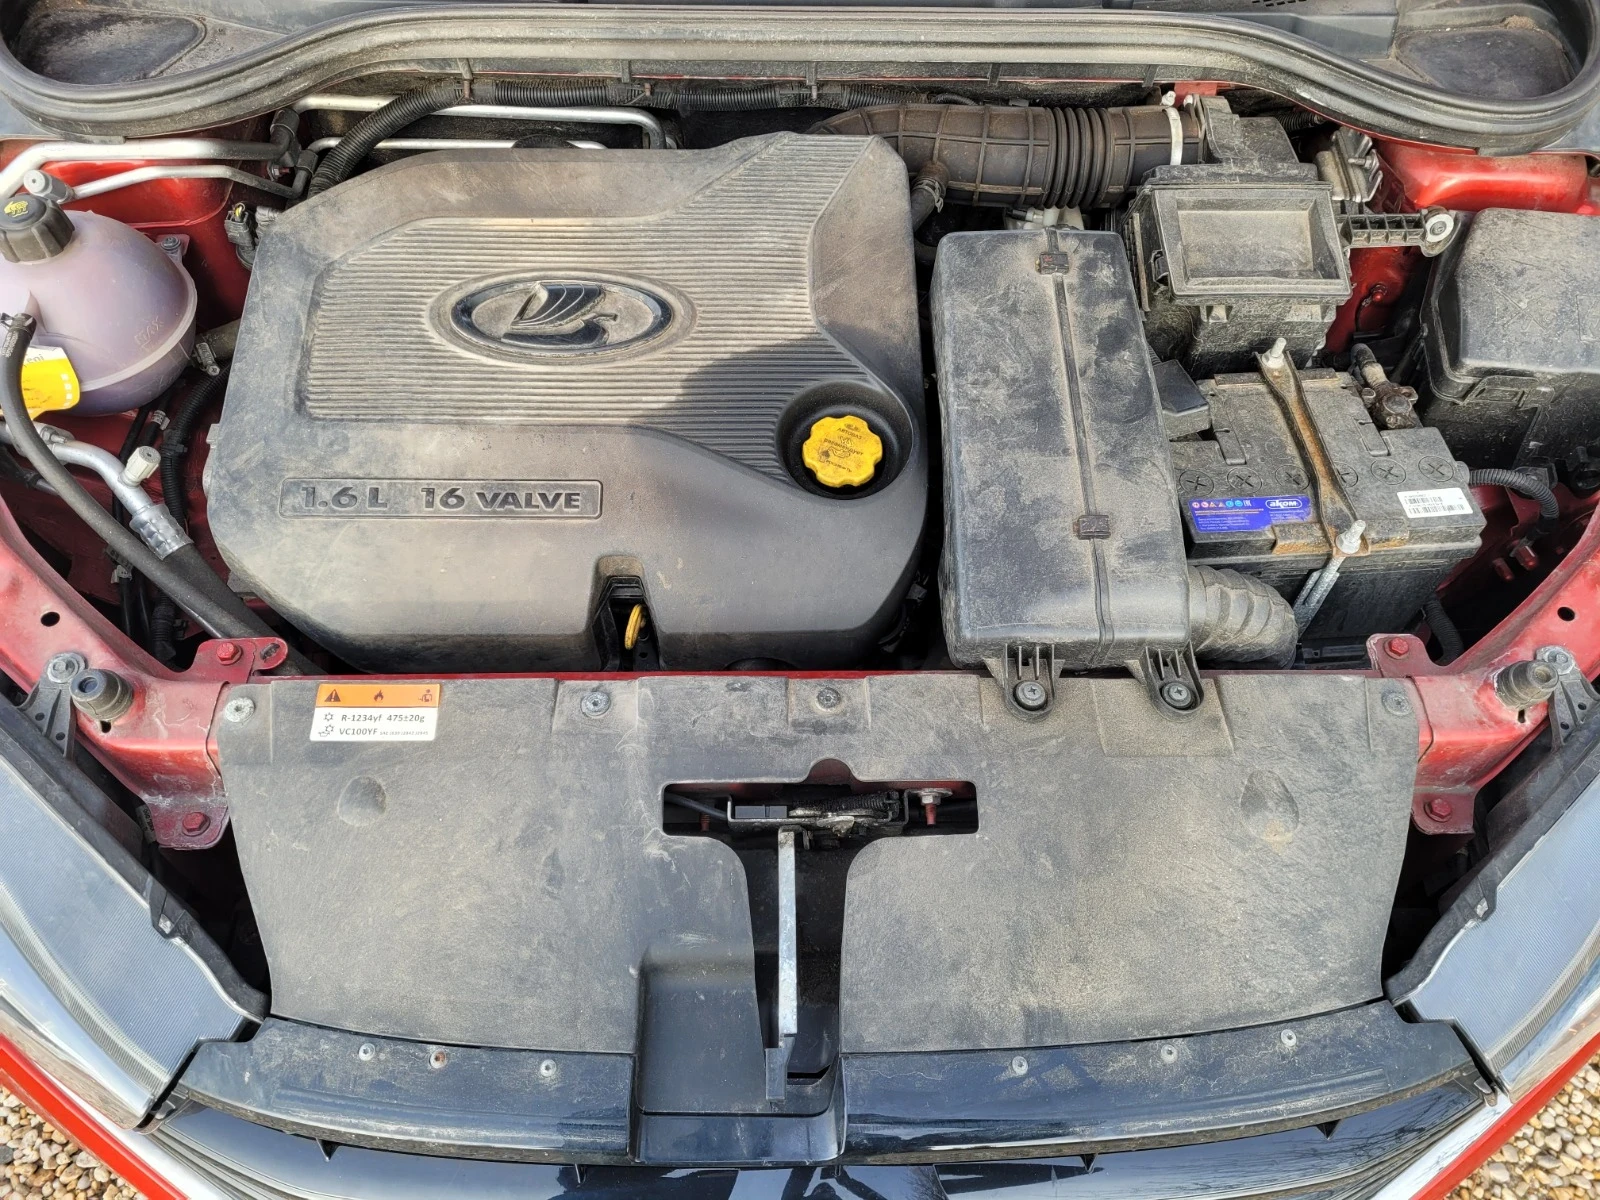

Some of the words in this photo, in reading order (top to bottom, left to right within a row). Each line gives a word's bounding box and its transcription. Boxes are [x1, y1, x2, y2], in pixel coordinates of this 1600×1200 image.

[301, 486, 358, 509] 1.6
[367, 486, 388, 509] L
[421, 487, 466, 510] 16
[475, 492, 581, 510] VALVE
[341, 714, 383, 723] R-1234yf
[386, 714, 425, 723] 475±20g
[339, 728, 378, 736] VC100YF
